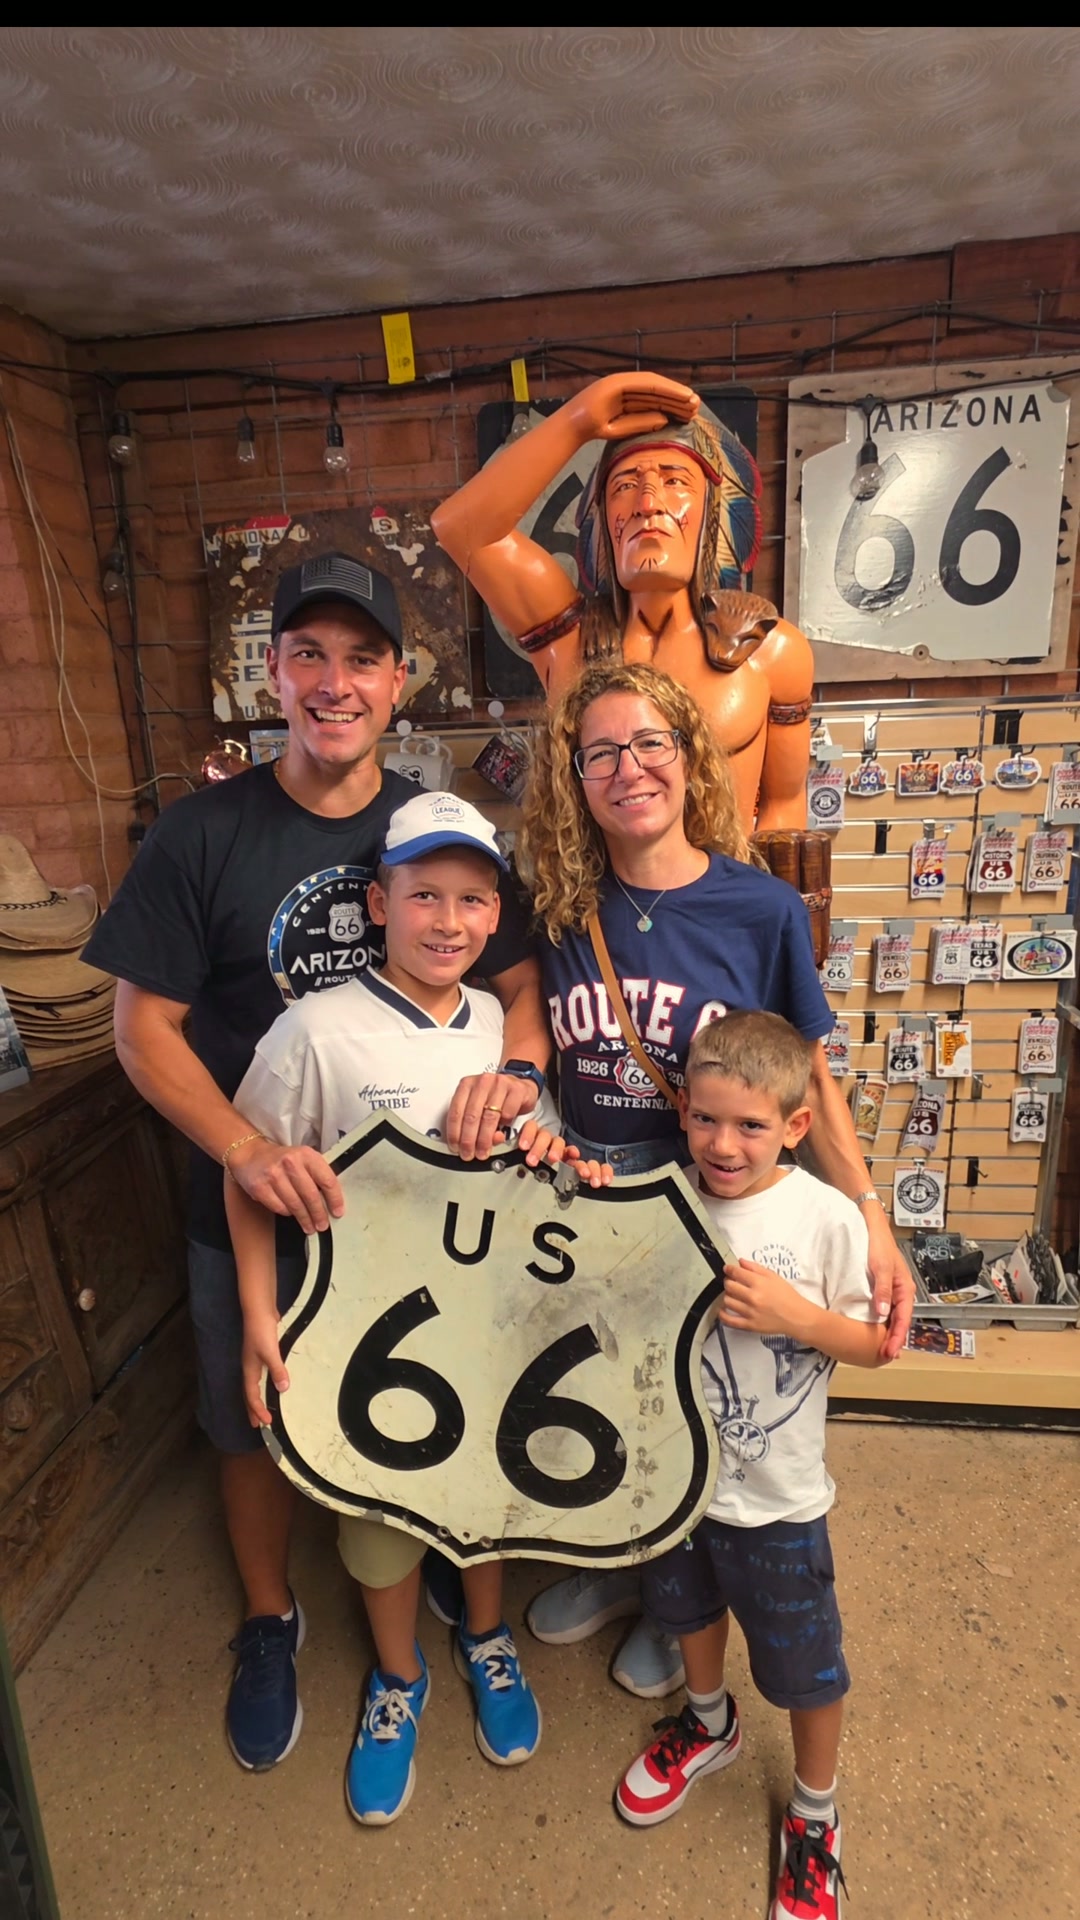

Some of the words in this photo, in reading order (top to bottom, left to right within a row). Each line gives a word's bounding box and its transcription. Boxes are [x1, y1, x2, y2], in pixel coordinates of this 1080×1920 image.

[872, 394, 1041, 433] ARIZONA
[834, 446, 1021, 612] 66
[861, 773, 877, 784] 66
[913, 773, 926, 781] 66
[955, 770, 972, 781] 66
[1060, 798, 1080, 809] 66
[984, 866, 1007, 880] 66
[1035, 866, 1055, 878] 66
[918, 874, 938, 885] 66
[333, 907, 356, 916] ROUTE
[334, 917, 359, 936] 66
[972, 955, 993, 967] 66
[827, 968, 846, 979] 66
[884, 968, 902, 979] 66
[548, 978, 686, 1051] ROUTE
[598, 1040, 679, 1063] ARONA
[1028, 1050, 1047, 1061] 66
[894, 1059, 914, 1070] 66
[576, 1058, 609, 1077] 1926
[668, 1070, 686, 1087] 20
[628, 1068, 653, 1085] 66
[358, 1082, 420, 1099] Adrenaline
[368, 1097, 411, 1111] TRIBE
[594, 1093, 679, 1111] CENTENNIA
[907, 1117, 933, 1134] 66
[1019, 1115, 1039, 1126] 66
[751, 1249, 791, 1267] Cyclo
[763, 1243, 799, 1267] ORIGINAL
[927, 1245, 949, 1258] 66
[337, 1284, 628, 1509] 66
